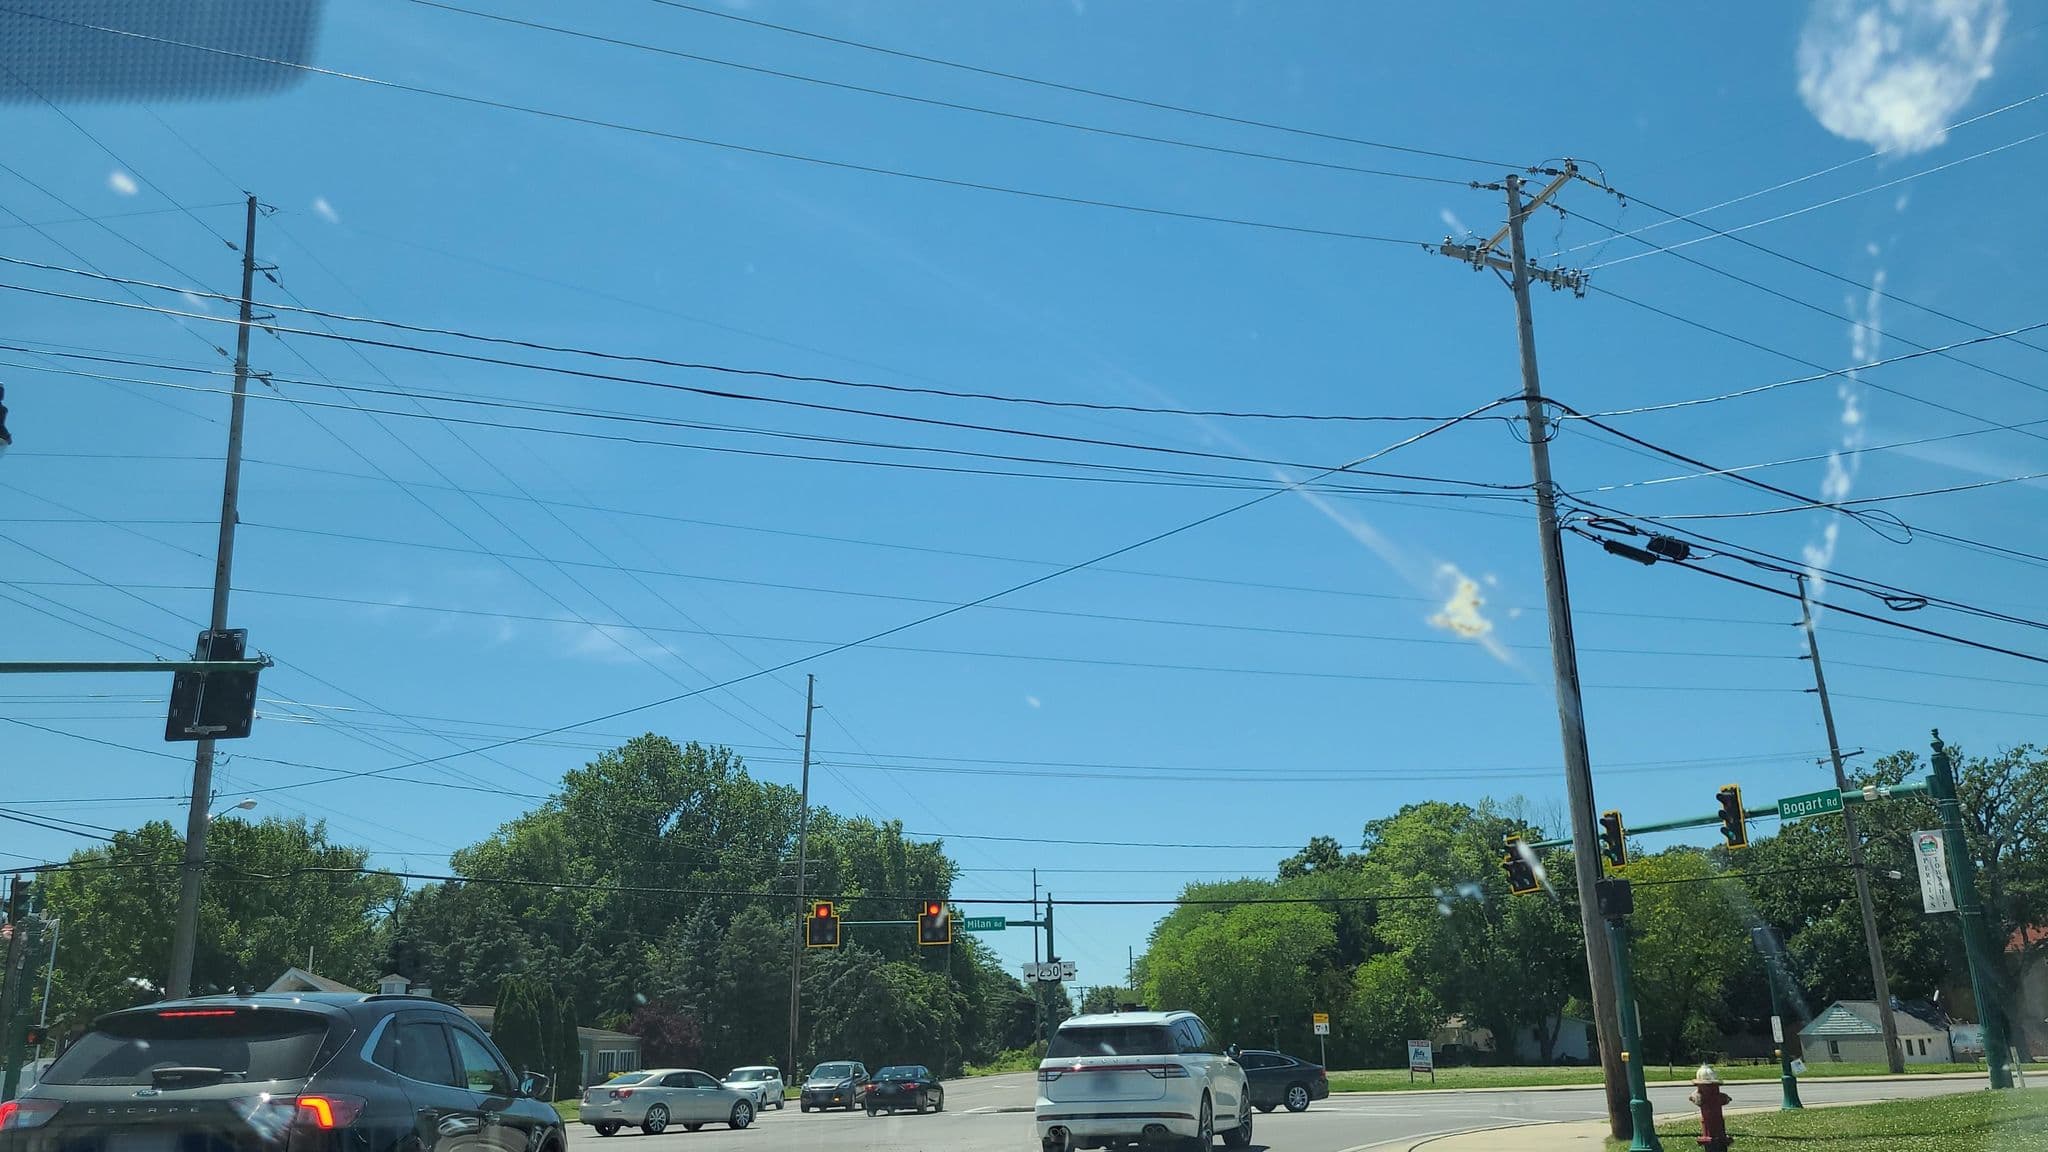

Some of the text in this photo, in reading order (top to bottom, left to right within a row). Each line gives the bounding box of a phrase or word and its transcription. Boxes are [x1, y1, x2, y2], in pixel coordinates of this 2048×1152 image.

[1783, 796, 1838, 815] Bogart Rd
[967, 919, 992, 929] Milan
[1040, 966, 1059, 977] 250
